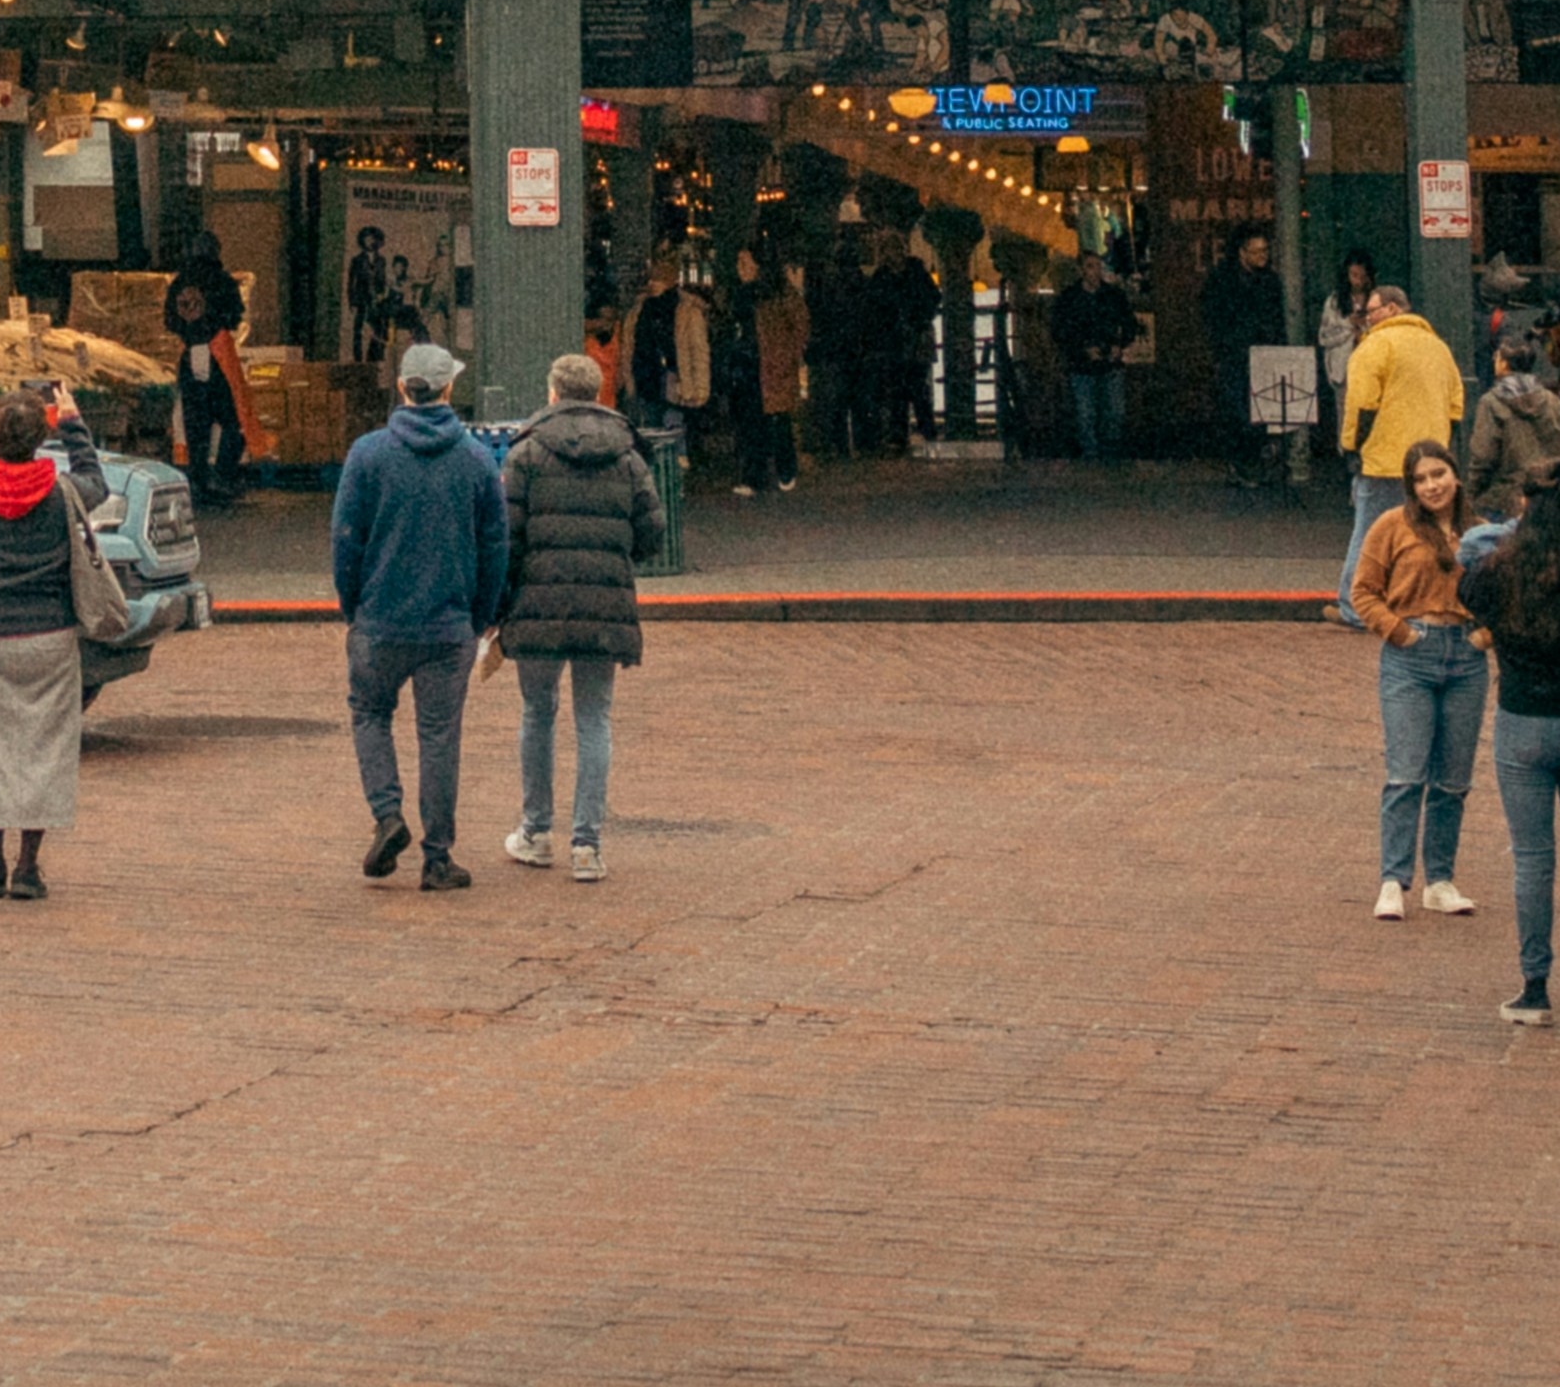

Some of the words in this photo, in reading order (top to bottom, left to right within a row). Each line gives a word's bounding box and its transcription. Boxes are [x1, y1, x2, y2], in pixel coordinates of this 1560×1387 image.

[955, 116, 1004, 130] PUBLIC
[1008, 115, 1070, 130] SEATING
[512, 153, 526, 164] NO
[515, 168, 552, 181] STOPS
[1423, 164, 1437, 176] NO
[1426, 179, 1463, 194] STOPS
